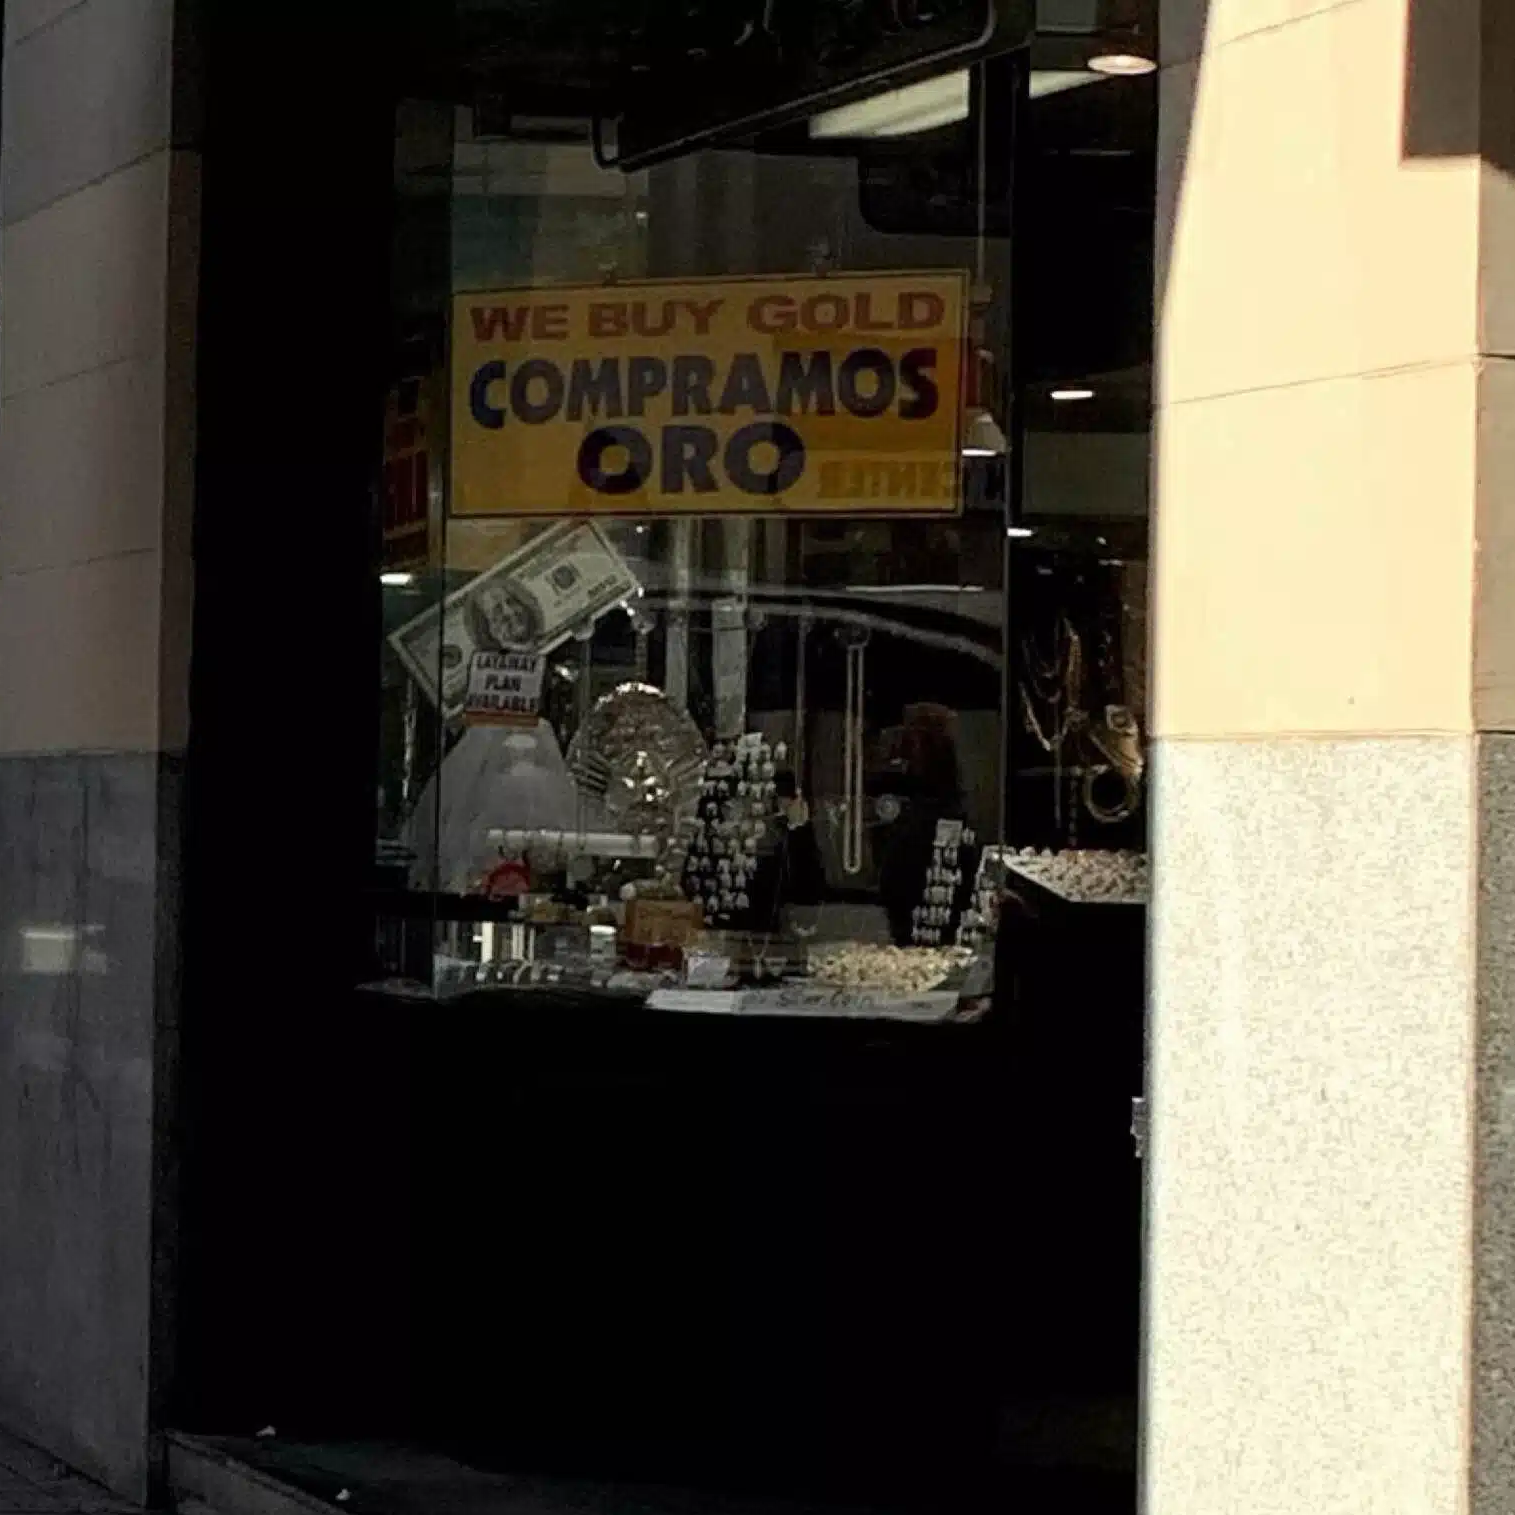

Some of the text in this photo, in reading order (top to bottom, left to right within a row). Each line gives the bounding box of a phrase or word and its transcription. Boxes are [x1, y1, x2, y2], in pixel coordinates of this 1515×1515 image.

[471, 292, 946, 342] WE BUY GOLD
[470, 347, 938, 430] COMPRAMOS
[576, 421, 806, 496] ORO
[486, 674, 523, 692] PLAN
